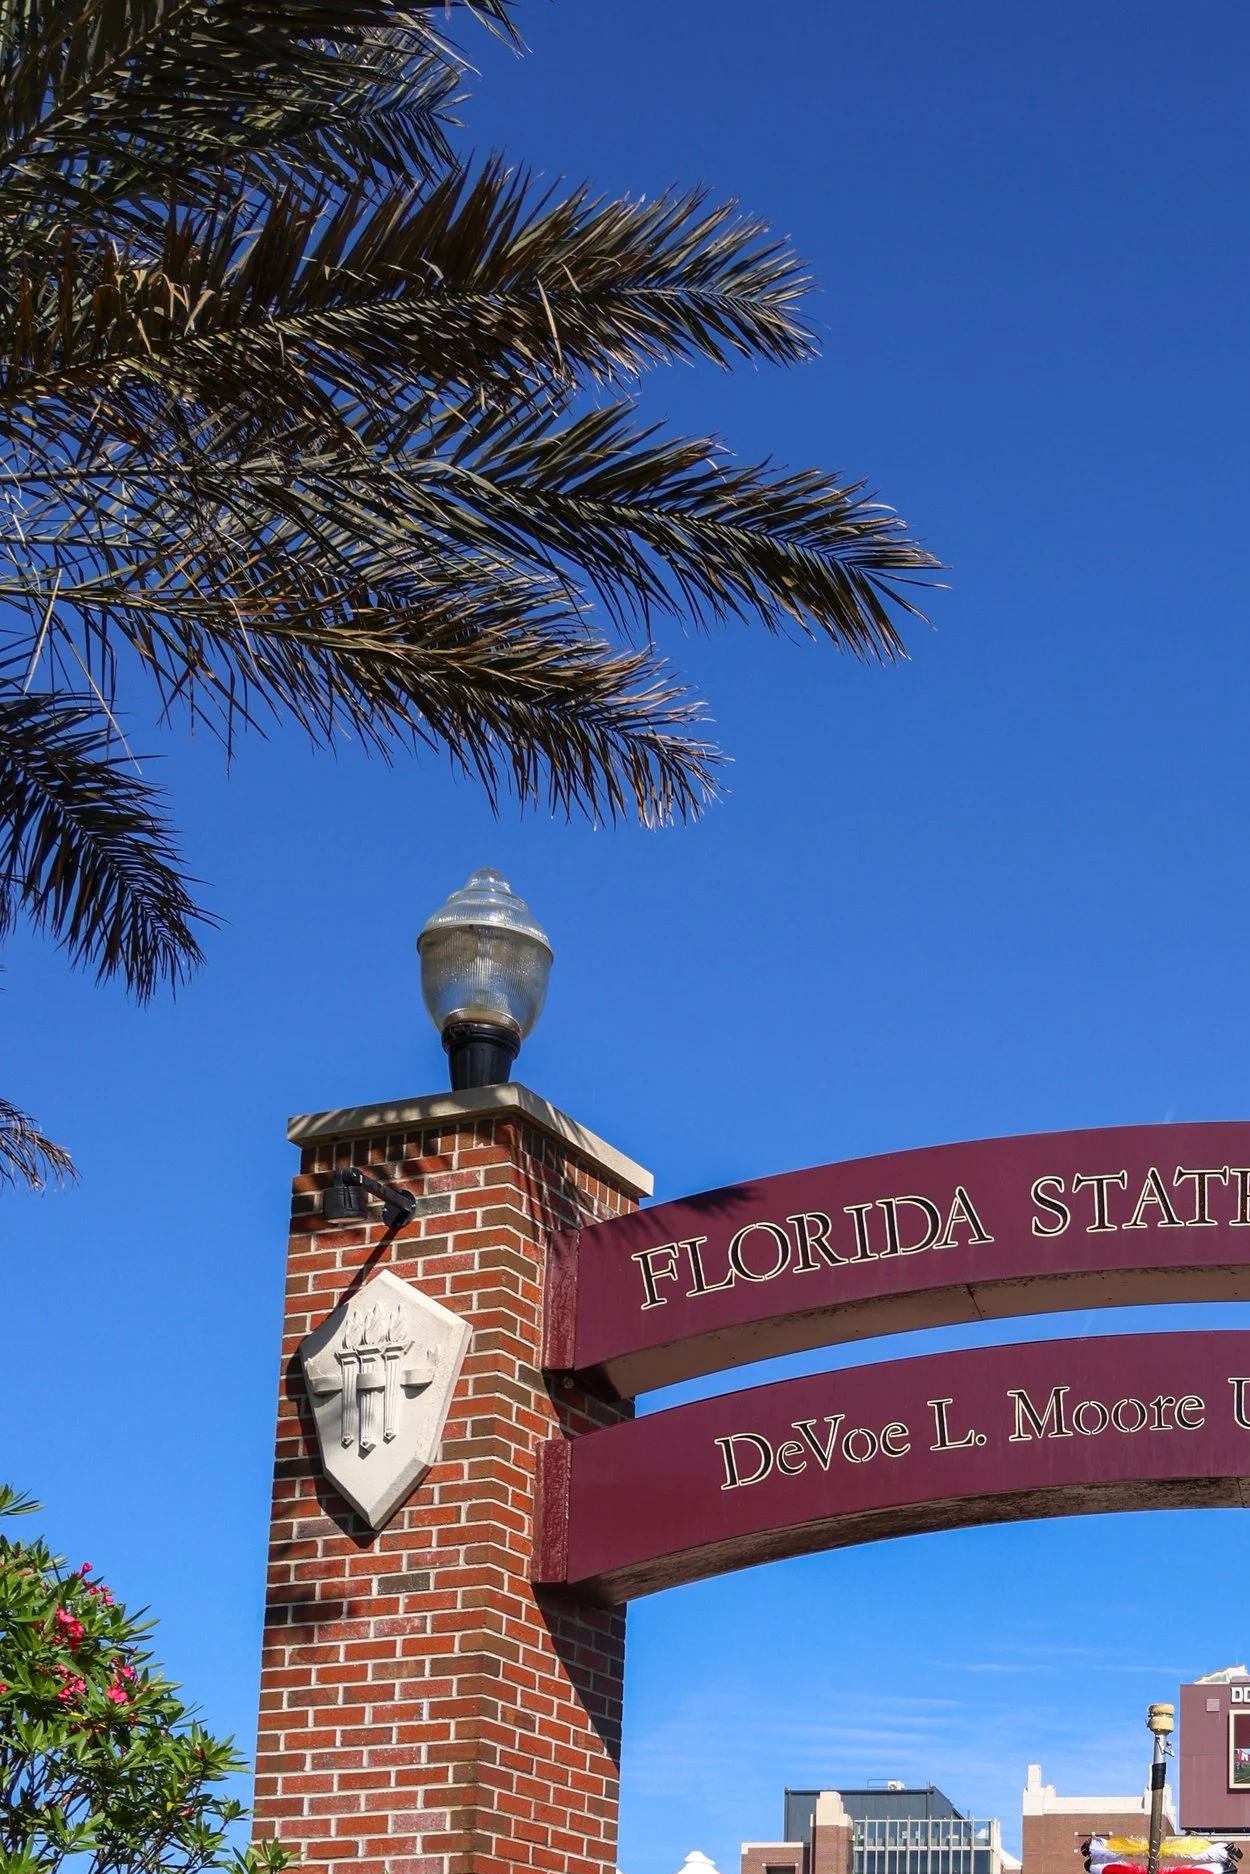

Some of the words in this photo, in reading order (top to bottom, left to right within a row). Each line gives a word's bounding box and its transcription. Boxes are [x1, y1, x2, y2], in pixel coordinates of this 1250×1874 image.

[631, 1186, 994, 1310] FLORIDA
[715, 1414, 911, 1490] DeVoe
[927, 1399, 987, 1451] L.
[1007, 1385, 1206, 1442] Moore
